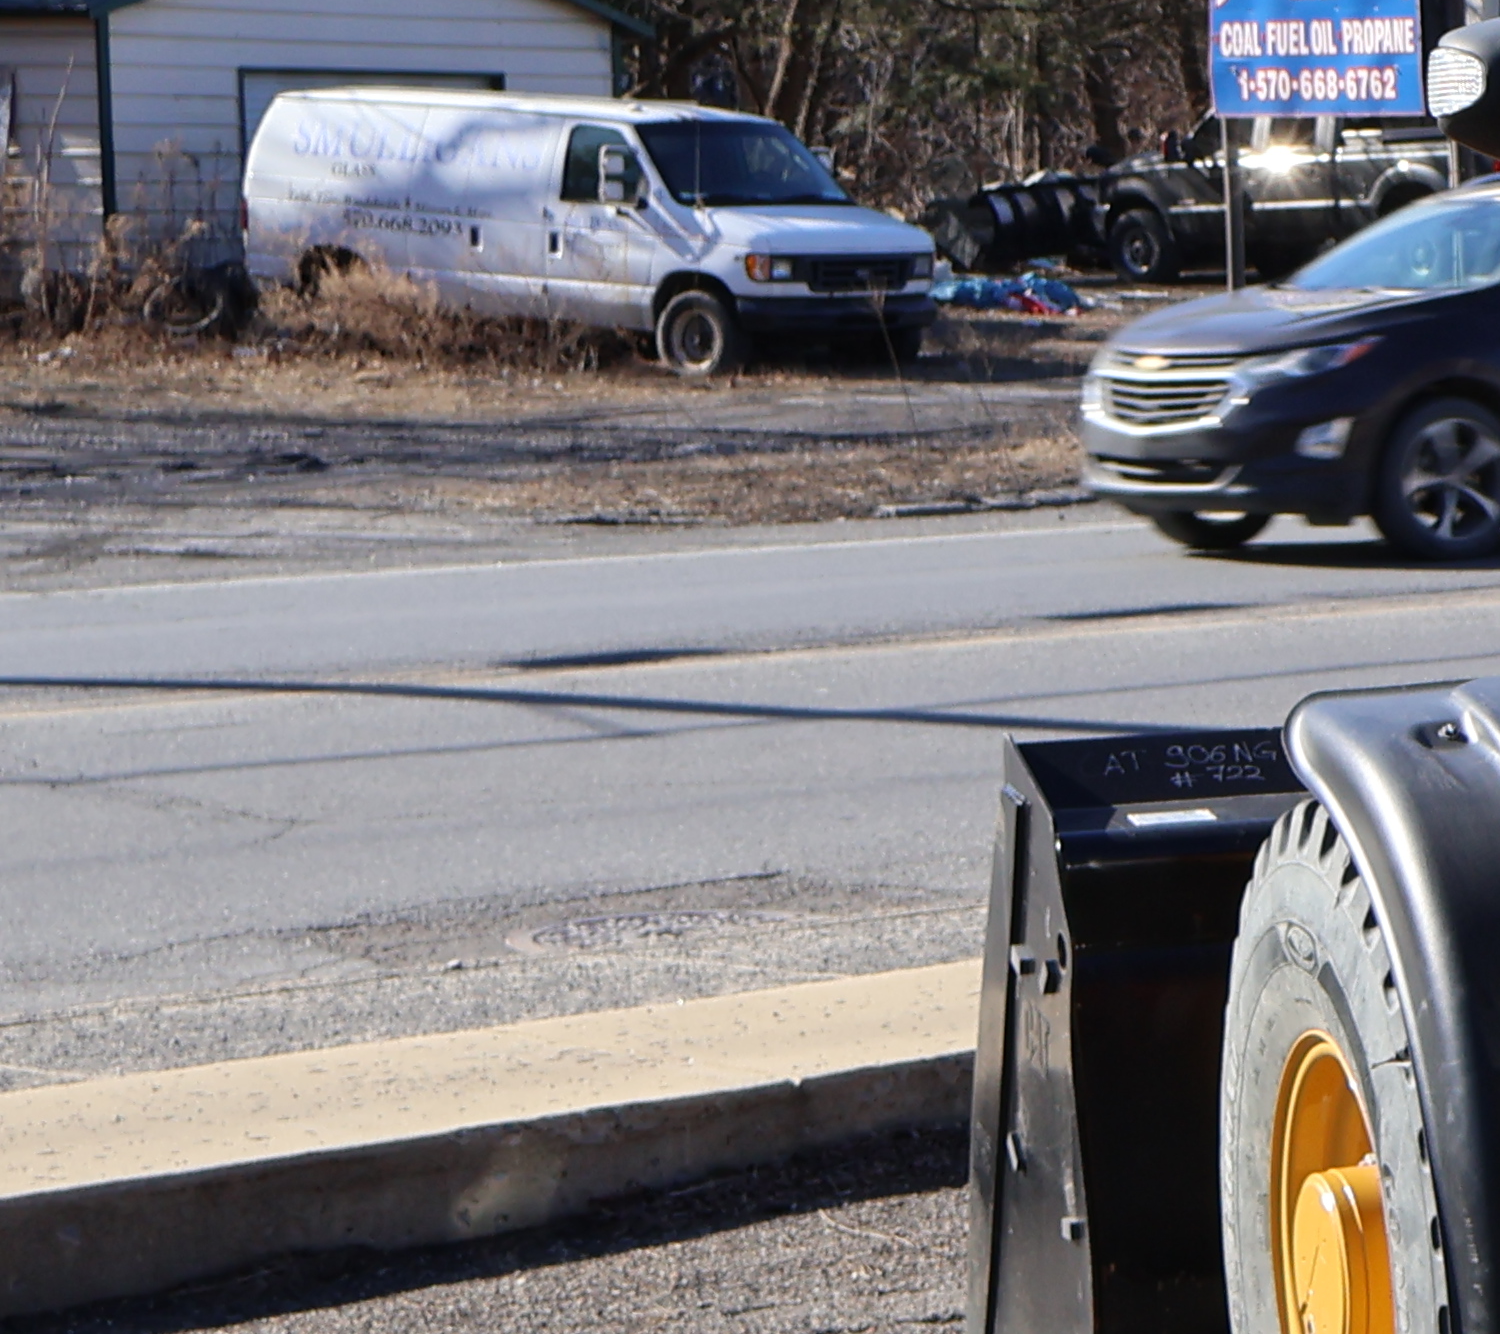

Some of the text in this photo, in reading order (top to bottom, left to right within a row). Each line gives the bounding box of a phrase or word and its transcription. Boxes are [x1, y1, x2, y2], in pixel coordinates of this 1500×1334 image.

[1266, 20, 1309, 57] FUEL
[1310, 19, 1337, 56] OIL
[1341, 17, 1416, 55] PROPANE
